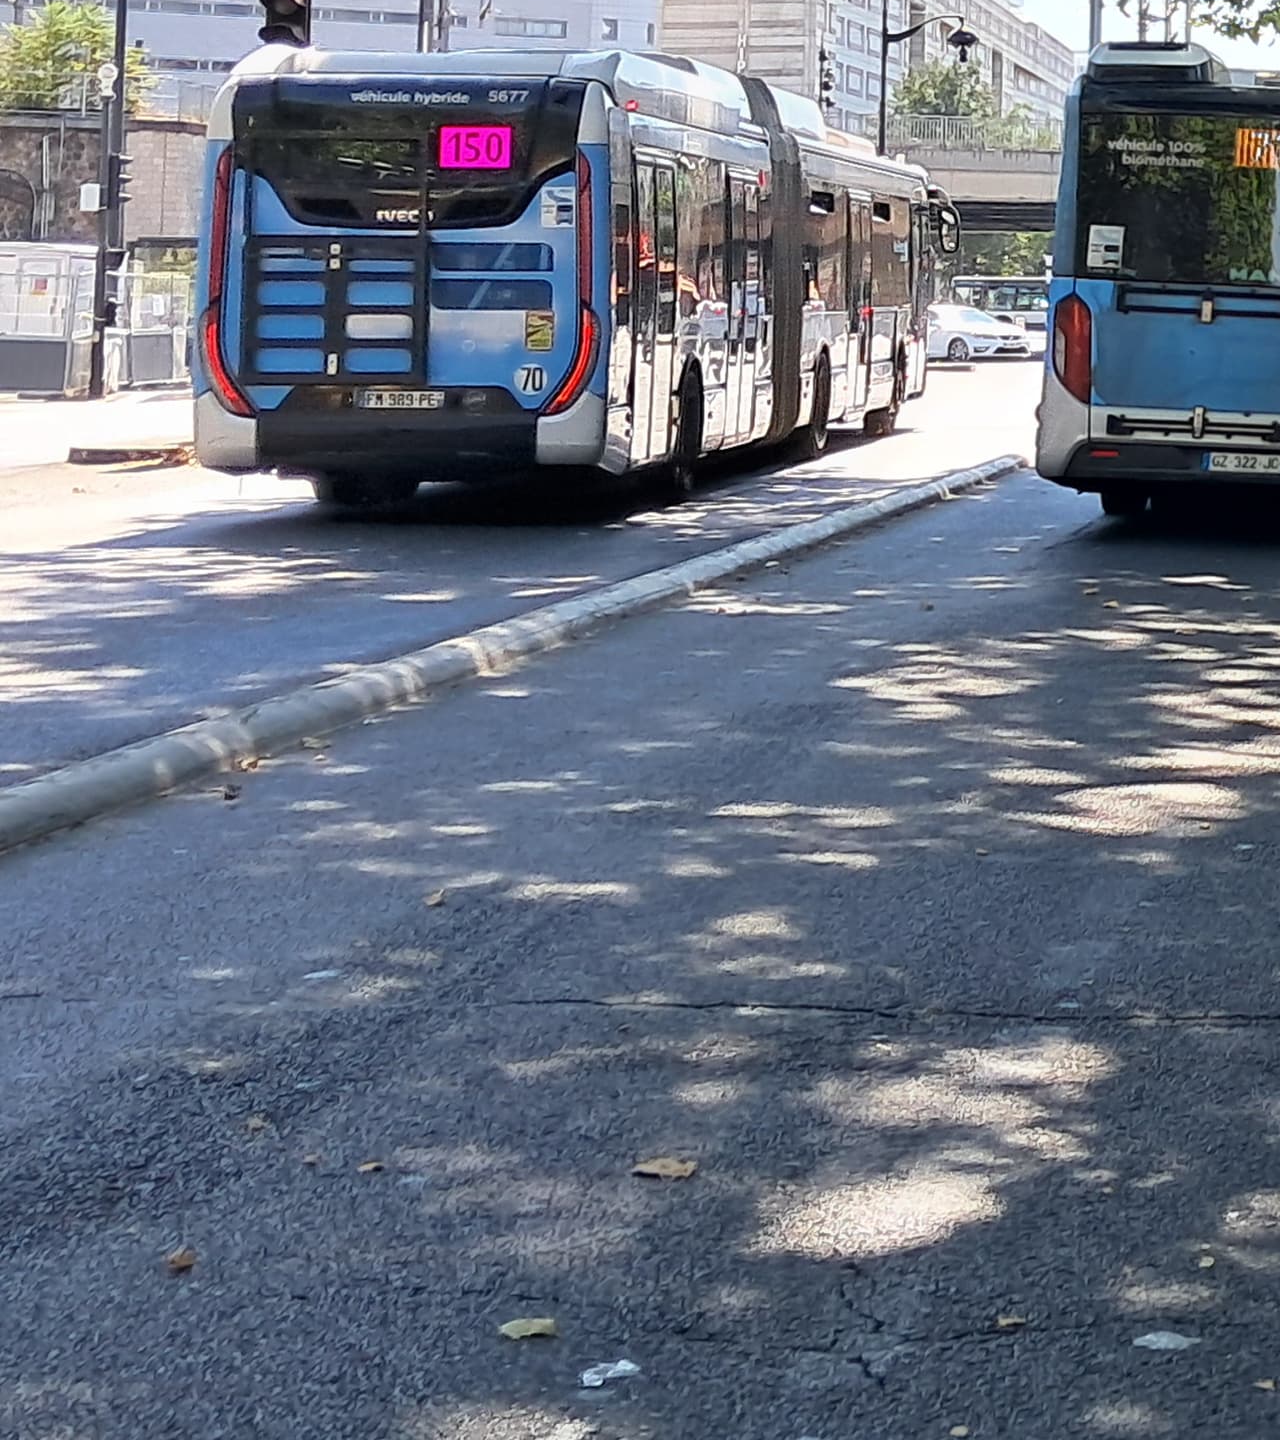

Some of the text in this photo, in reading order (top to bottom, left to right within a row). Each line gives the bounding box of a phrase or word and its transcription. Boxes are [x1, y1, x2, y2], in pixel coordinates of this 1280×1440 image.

[350, 89, 471, 106] véhicule hybride
[487, 89, 530, 103] 5677
[447, 131, 504, 163] 150
[1107, 134, 1165, 152] véhicule
[520, 367, 544, 392] 70
